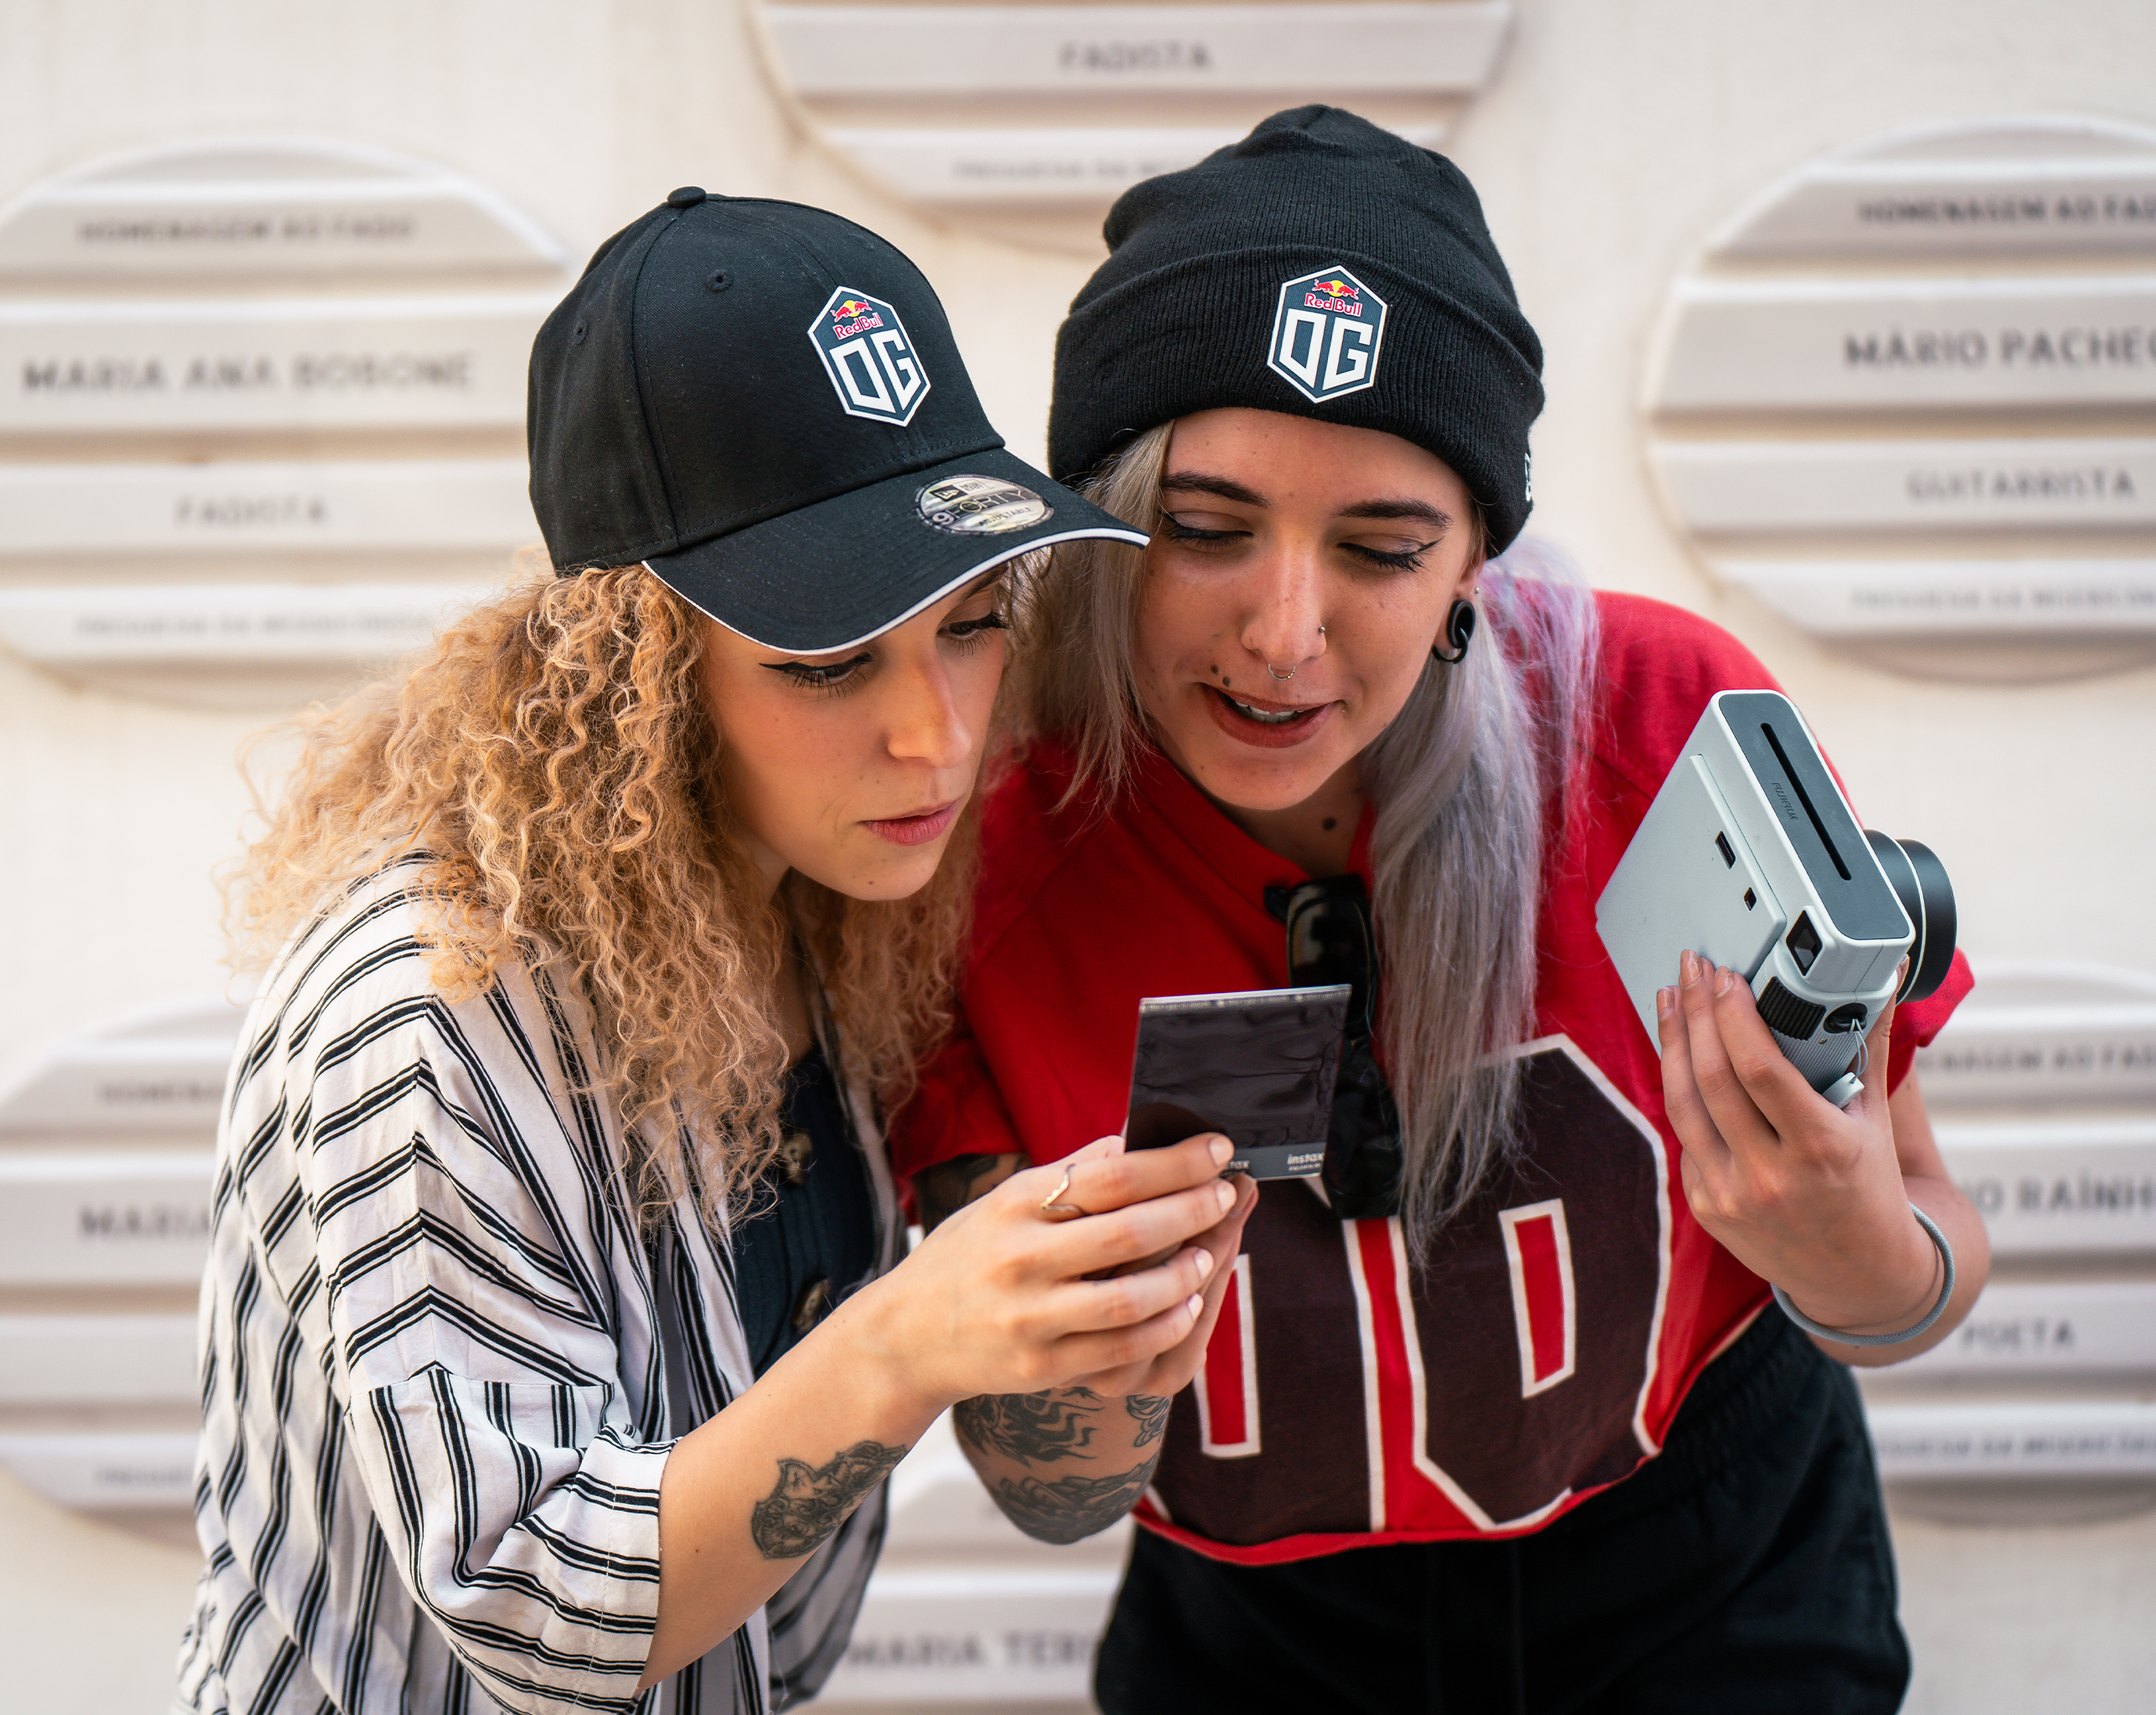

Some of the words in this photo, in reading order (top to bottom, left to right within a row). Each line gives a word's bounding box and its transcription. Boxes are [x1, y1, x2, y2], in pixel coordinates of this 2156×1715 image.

[832, 317, 863, 340] Red
[858, 312, 884, 331] Bull
[1304, 292, 1335, 311] Red
[1333, 298, 1363, 317] Bull
[1279, 307, 1374, 391] OG
[1844, 324, 1990, 368] MÁRIO
[2001, 323, 2156, 366] PACHE
[22, 358, 168, 398] MARIA
[183, 357, 279, 394] ANA
[291, 352, 476, 393] BOBONE
[829, 328, 922, 414] OG
[932, 489, 1027, 526] 9FORTY
